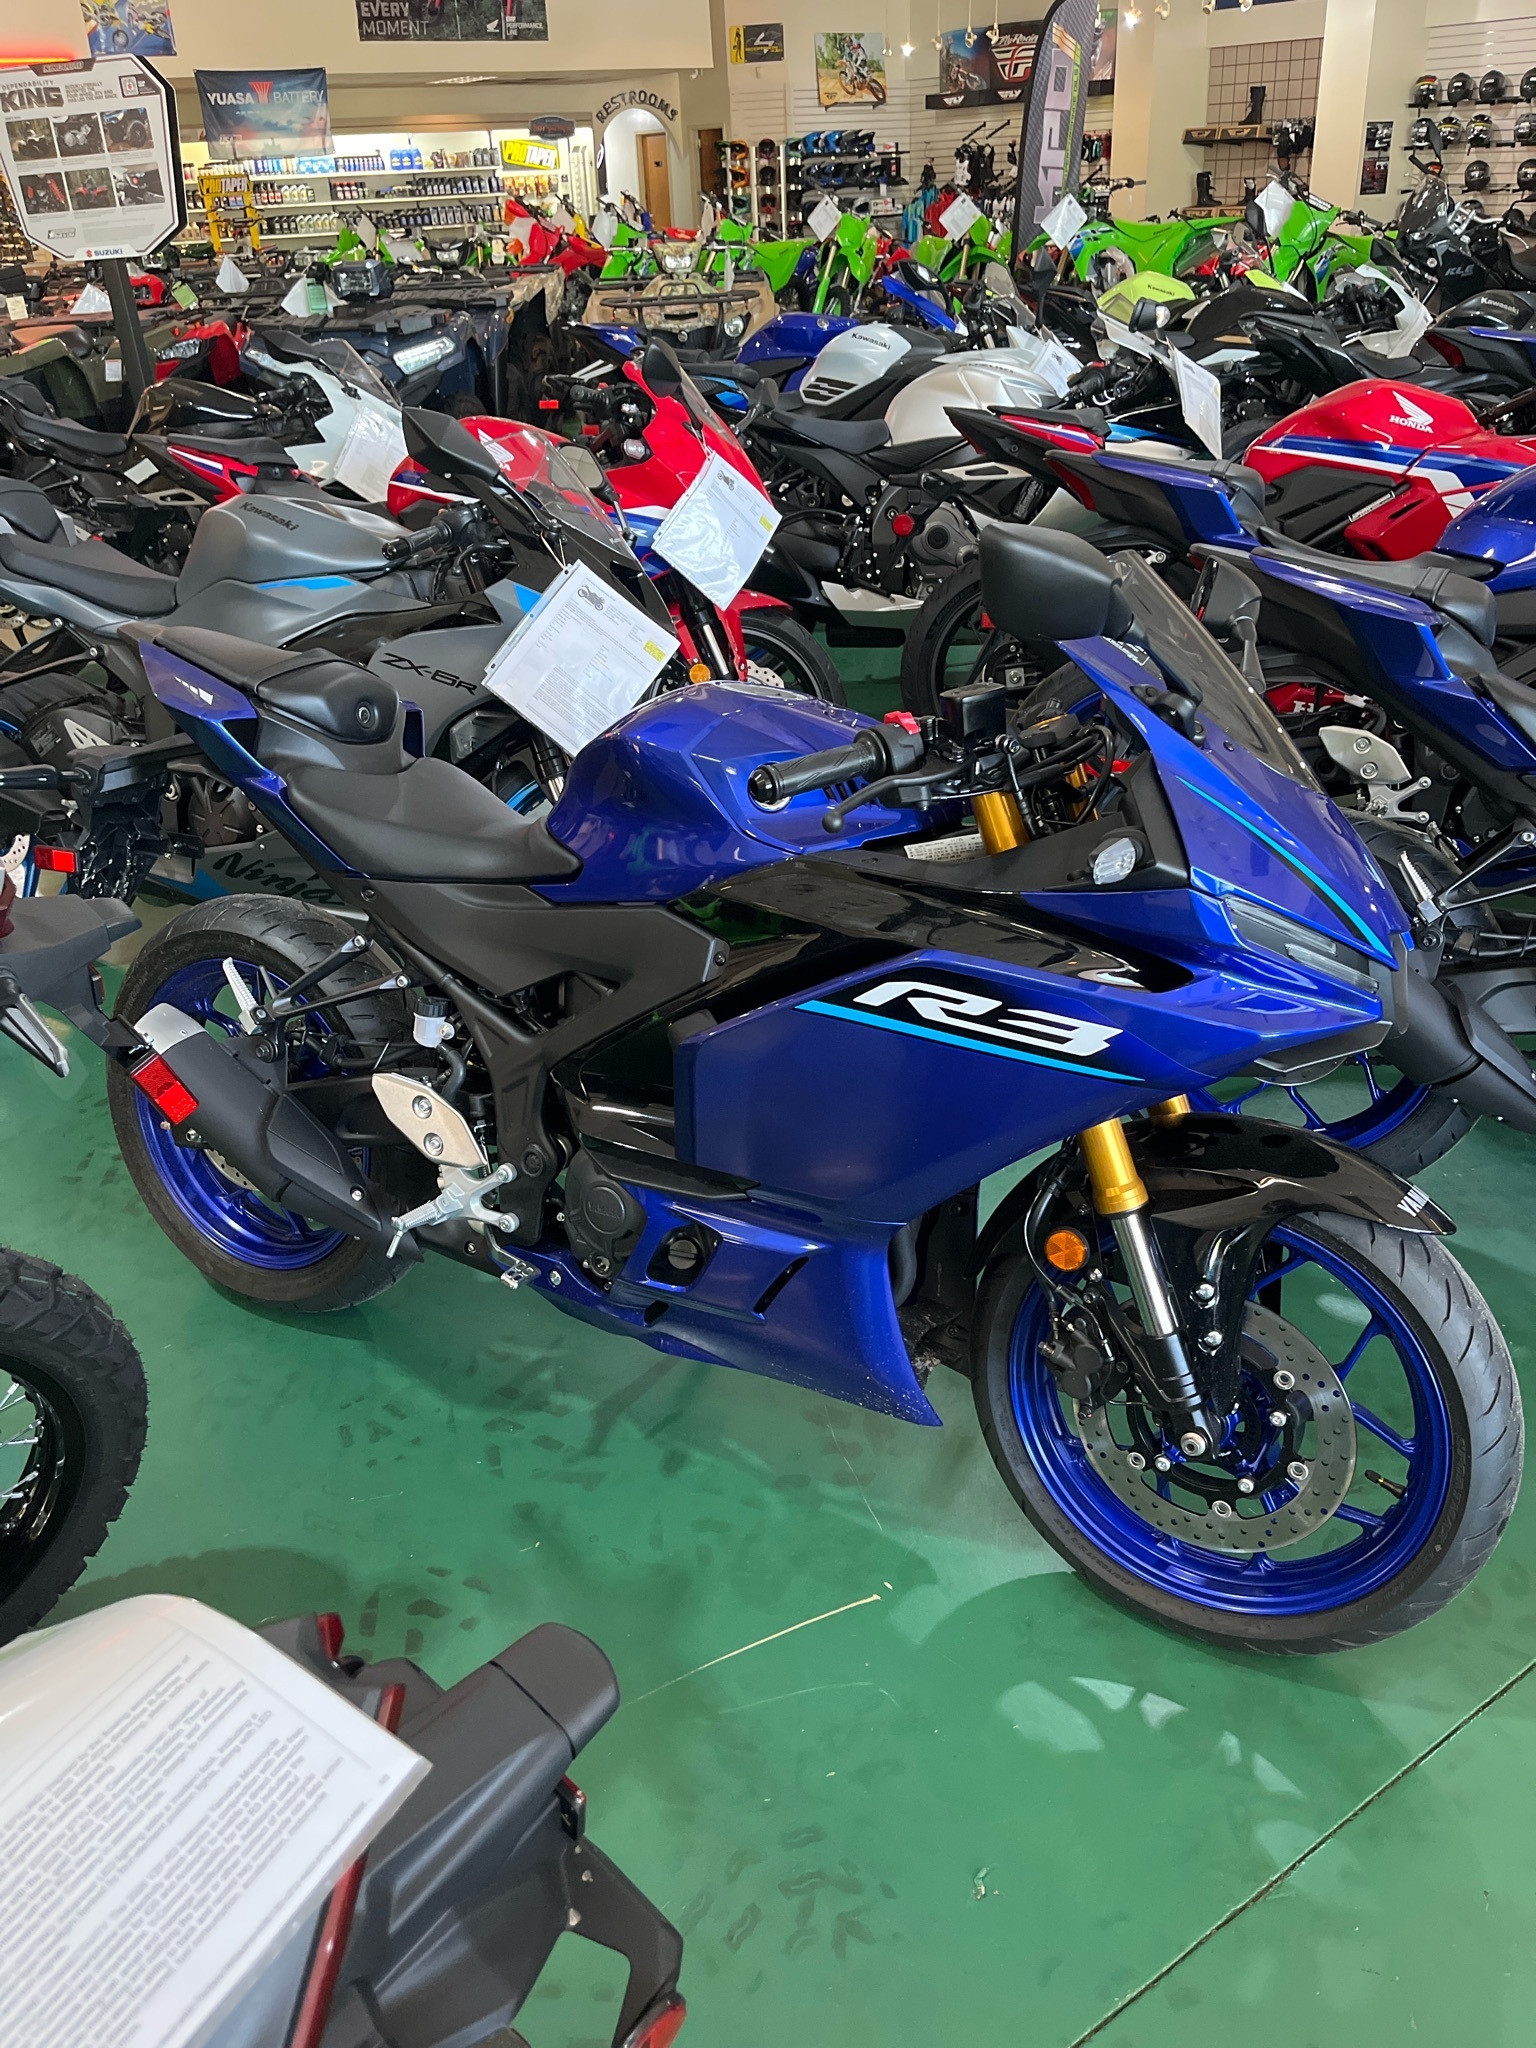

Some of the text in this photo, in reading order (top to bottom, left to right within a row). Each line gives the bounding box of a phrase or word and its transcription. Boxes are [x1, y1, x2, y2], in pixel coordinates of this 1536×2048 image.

[360, 2, 409, 17] EVERY
[363, 20, 429, 36] MOMENT
[1012, 33, 1039, 43] Racin
[0, 87, 64, 113] KING
[207, 90, 324, 105] YUASA BATTERY
[596, 90, 678, 124] RESTROOMS
[94, 248, 123, 256] SUZUKI
[1481, 297, 1519, 315] Kawasaki
[851, 332, 891, 350] Kawasaki
[1389, 415, 1434, 434] HONDA
[239, 501, 299, 531] Kawasaki
[380, 652, 477, 695] ZX-6R
[212, 852, 345, 905] Ninja
[853, 981, 1123, 1056] R3
[253, 1709, 272, 1728] LED
[239, 1738, 280, 1780] Motorcycle
